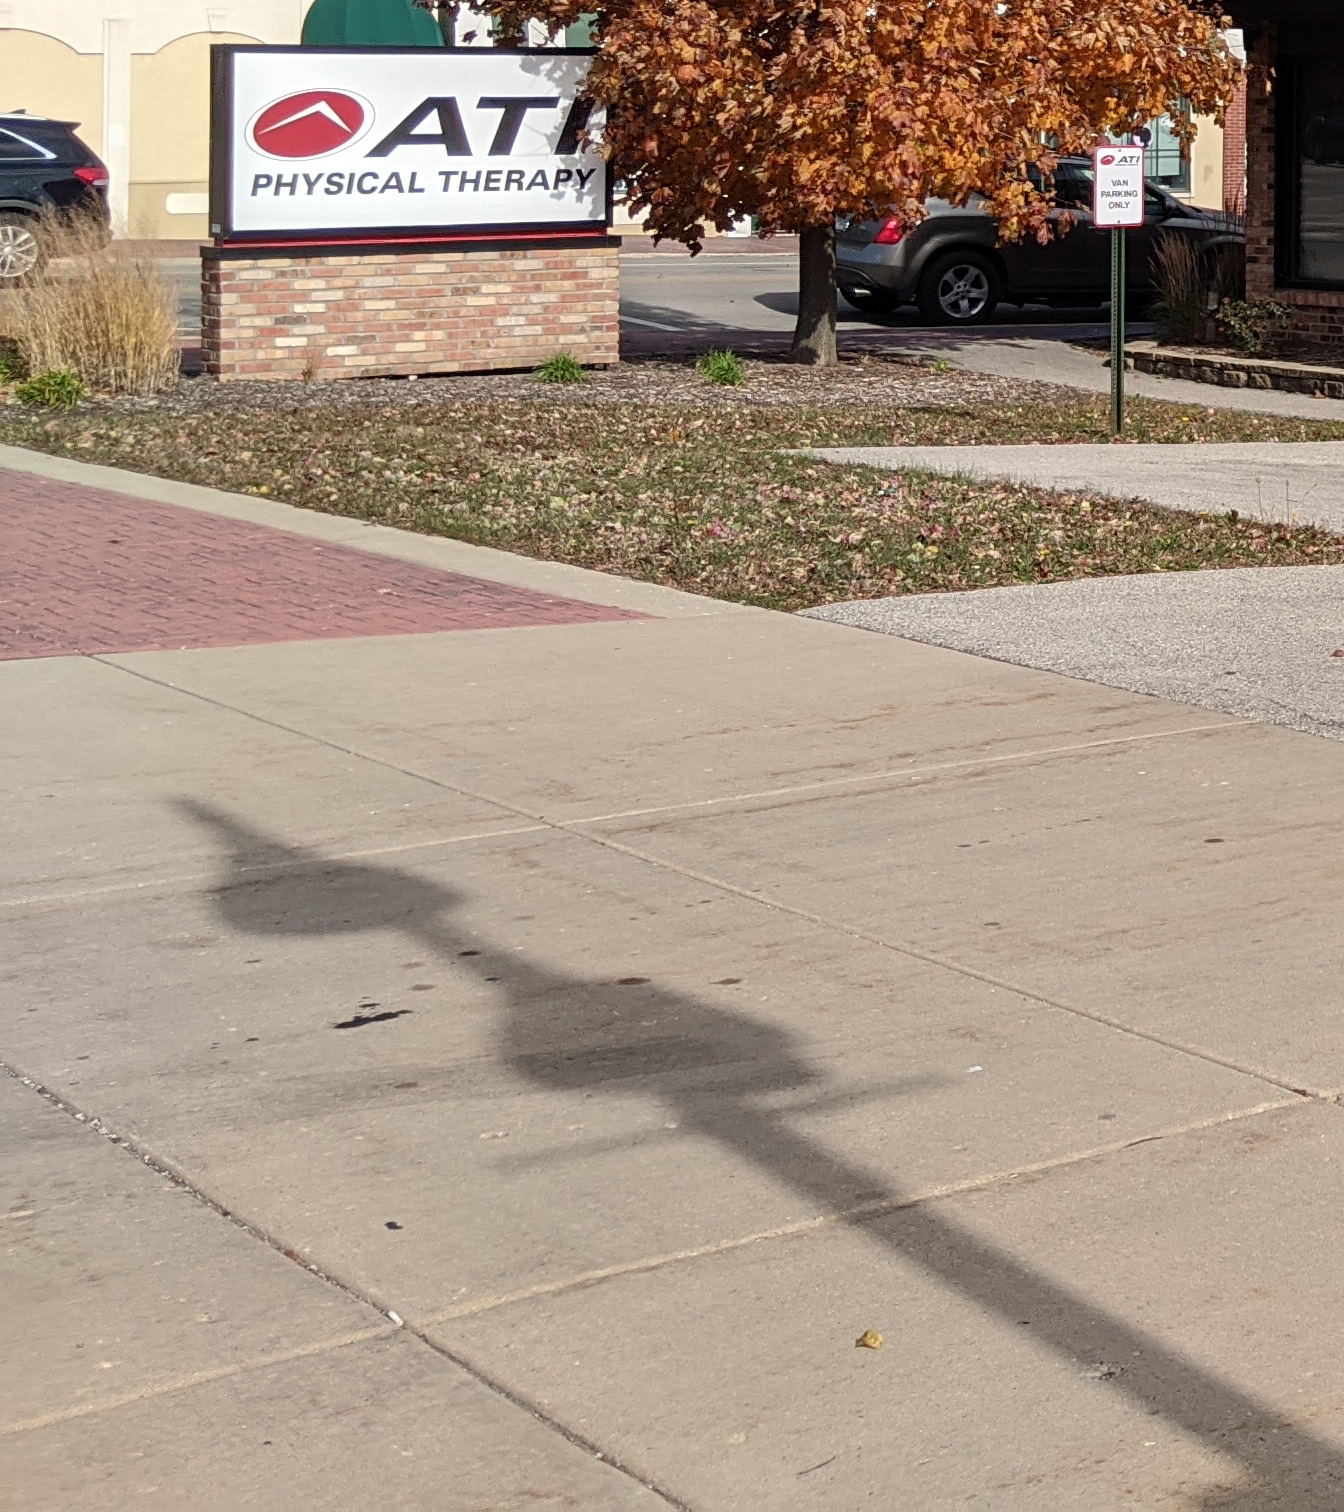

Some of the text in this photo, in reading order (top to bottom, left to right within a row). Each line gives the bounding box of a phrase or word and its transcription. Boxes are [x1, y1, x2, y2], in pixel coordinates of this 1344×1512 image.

[363, 96, 598, 158] ATI
[1118, 155, 1141, 164] ATI
[251, 168, 596, 197] PHYSICAL THERAPY
[1111, 179, 1129, 187] VAN
[1100, 190, 1138, 198] PARKING
[1108, 201, 1130, 209] ONLY
